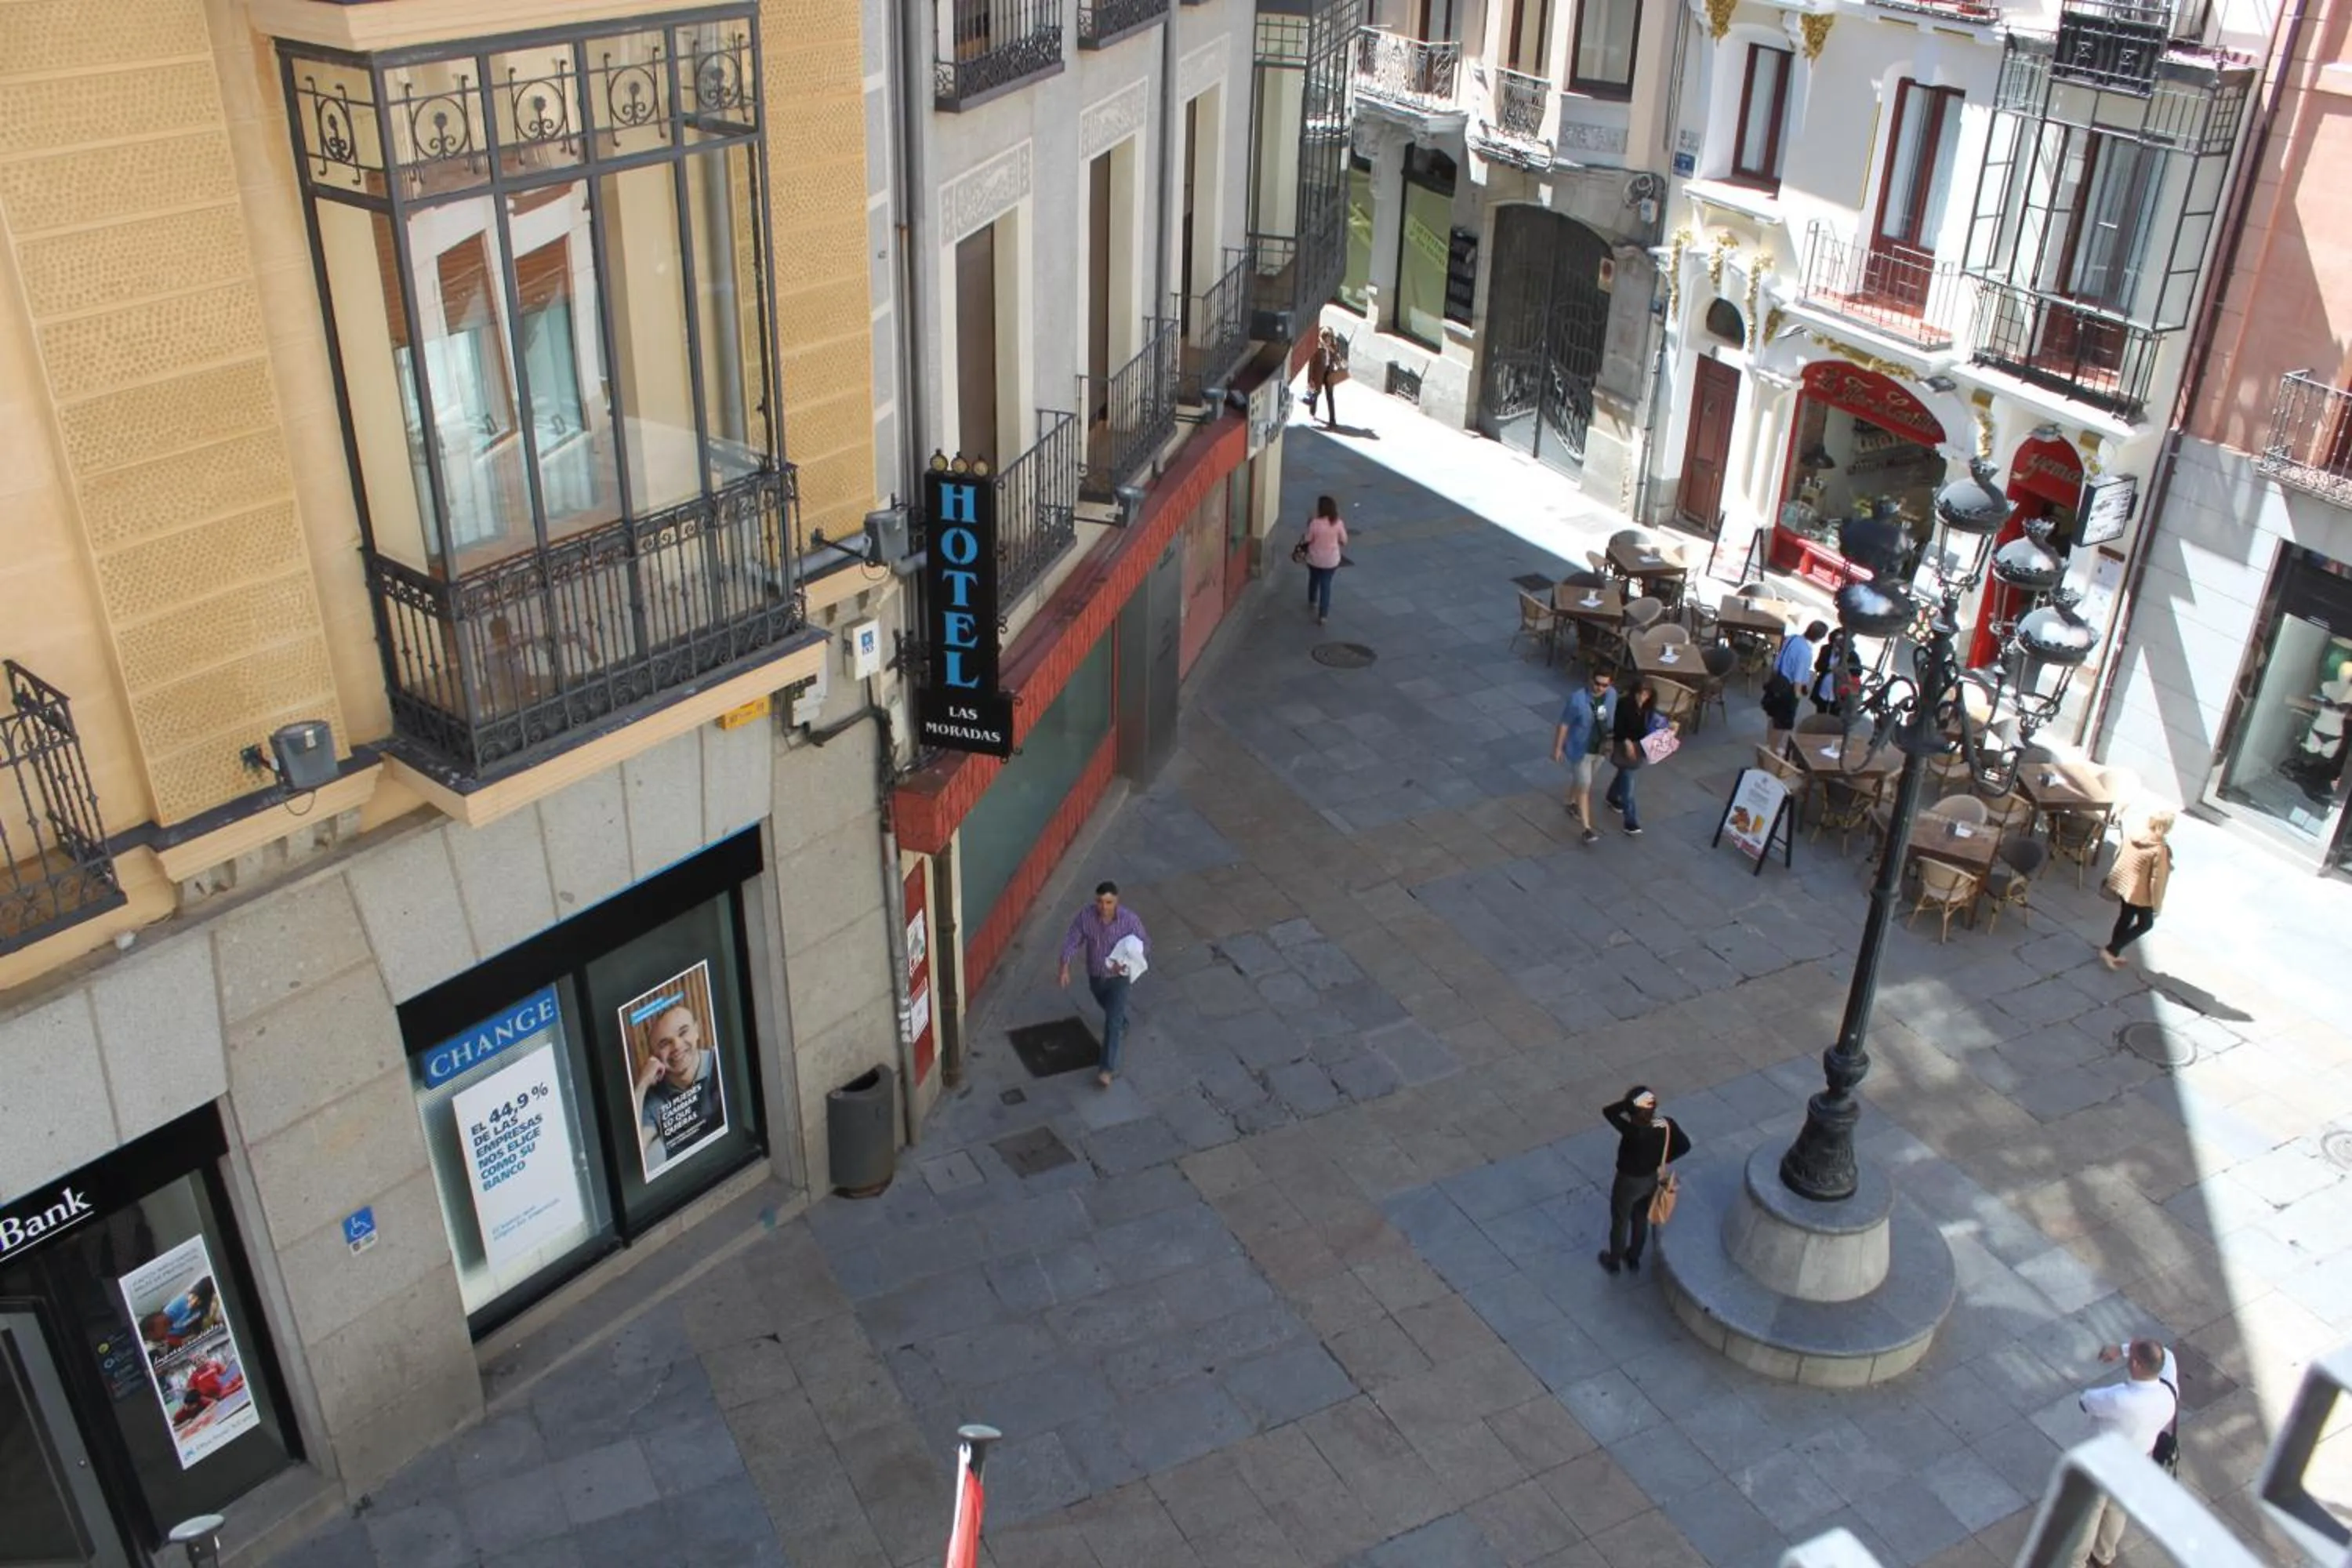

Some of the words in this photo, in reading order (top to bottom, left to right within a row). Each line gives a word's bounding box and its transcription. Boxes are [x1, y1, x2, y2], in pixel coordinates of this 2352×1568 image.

[940, 482, 979, 689] HOTEL
[926, 721, 1001, 742] MORADAS
[949, 706, 978, 720] LAS
[430, 998, 554, 1077] CHANGE
[470, 1122, 486, 1135] EL
[474, 1131, 490, 1146] DE
[494, 1116, 518, 1135] LAS
[476, 1114, 543, 1158] EMPRESAS
[478, 1149, 504, 1170] NOS
[507, 1127, 540, 1152] ELIGE
[481, 1153, 517, 1179] COMO
[520, 1142, 535, 1157] SU
[483, 1160, 525, 1191] BANCO
[0, 1187, 93, 1251] Bank
